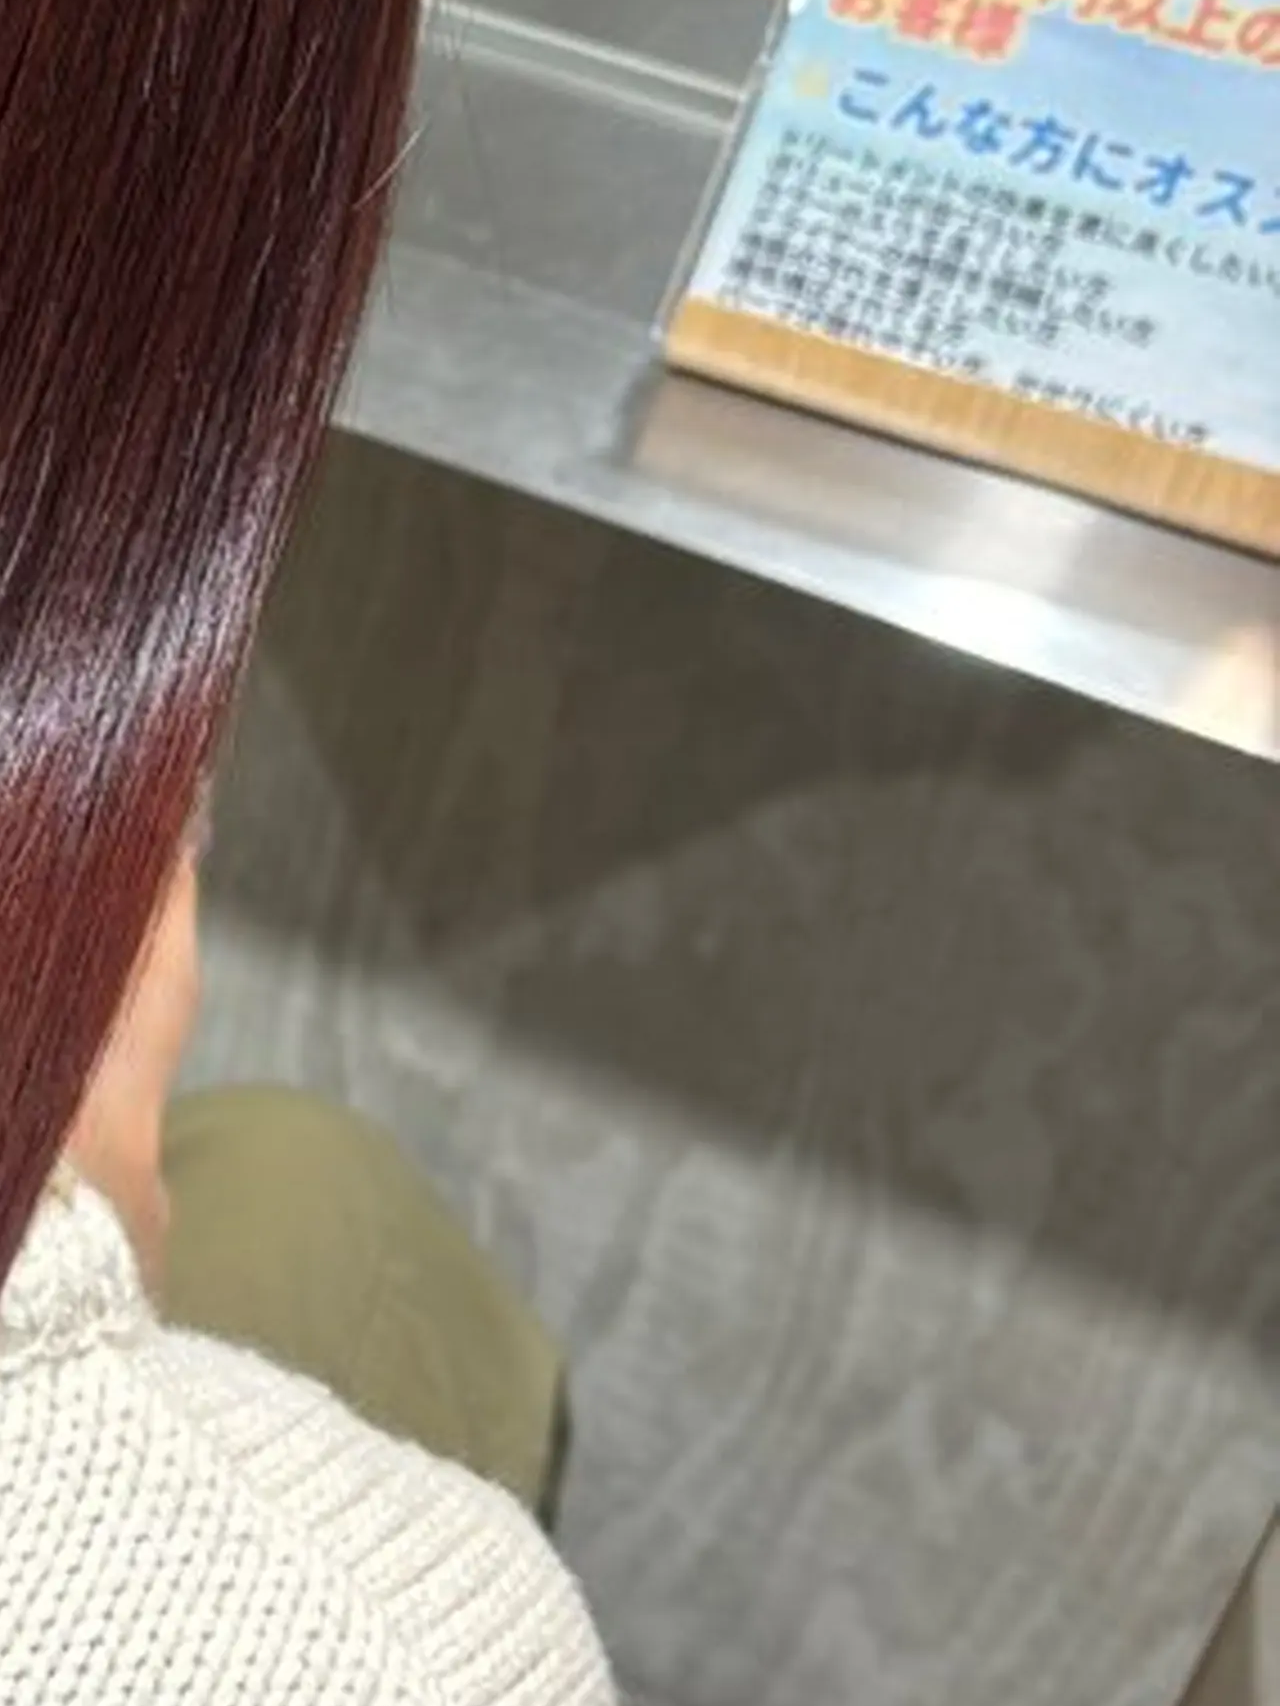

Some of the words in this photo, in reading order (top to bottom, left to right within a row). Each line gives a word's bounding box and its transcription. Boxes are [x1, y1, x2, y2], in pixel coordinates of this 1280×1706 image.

[839, 68, 1280, 234] こんな方にオス
